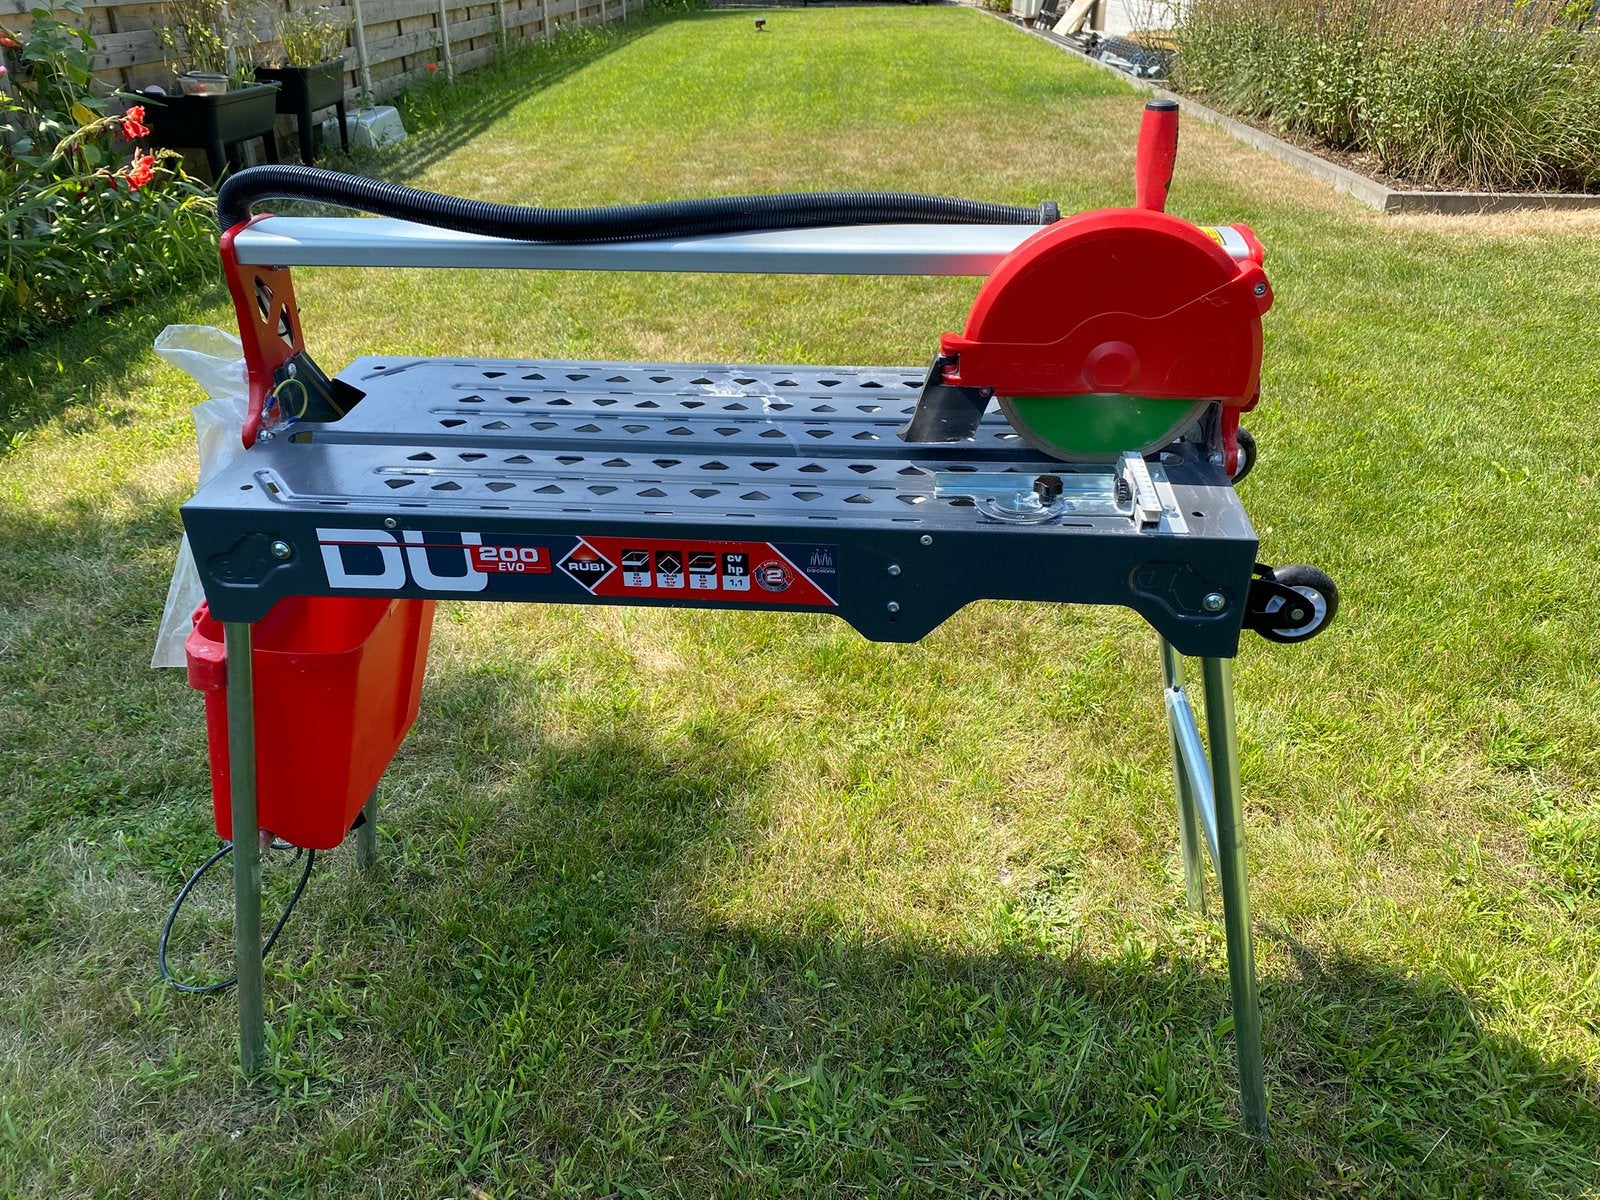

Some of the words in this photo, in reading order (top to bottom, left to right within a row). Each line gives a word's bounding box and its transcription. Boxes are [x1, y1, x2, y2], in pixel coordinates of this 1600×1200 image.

[315, 528, 488, 592] DU
[479, 547, 539, 562] 200
[498, 562, 525, 572] EVO
[568, 562, 605, 572] RUBI
[727, 564, 744, 575] hp
[766, 568, 783, 582] 2
